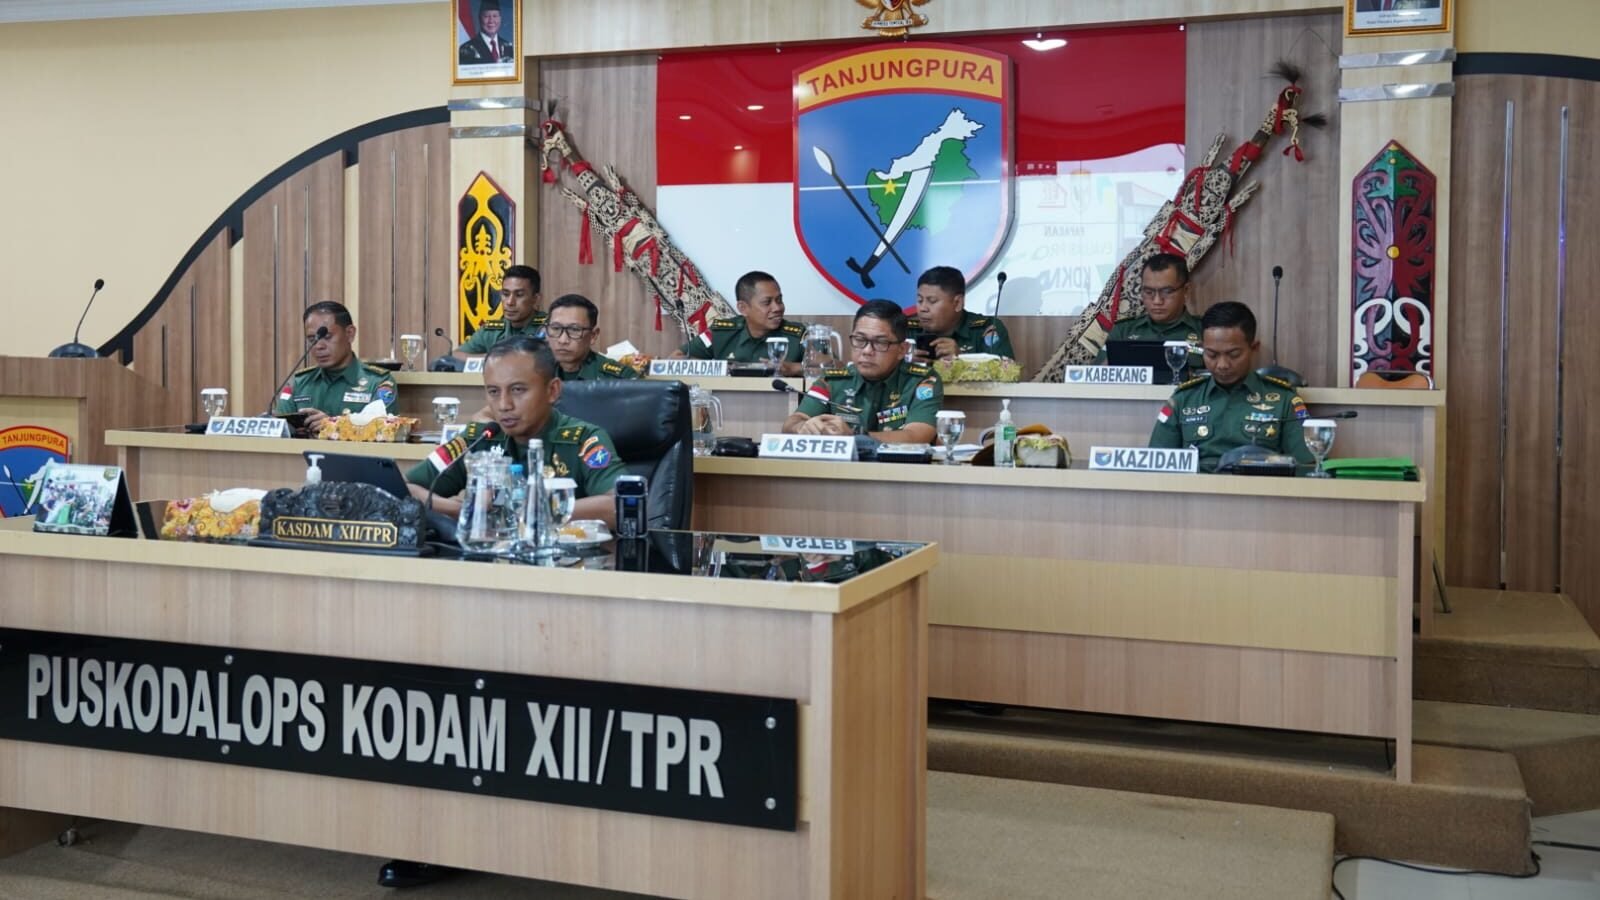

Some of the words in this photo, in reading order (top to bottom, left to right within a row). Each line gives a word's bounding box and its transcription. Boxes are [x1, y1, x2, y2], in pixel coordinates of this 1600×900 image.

[807, 59, 995, 96] TANJUNGPURA
[667, 361, 722, 375] KAPALDAM
[1085, 368, 1148, 382] KABEKANG
[224, 419, 281, 434] ASREN
[2, 431, 64, 448] TANJUNGPURA
[781, 438, 848, 454] ASTER
[1113, 449, 1193, 470] KAZIDAM
[277, 520, 333, 539] KASDAM
[340, 524, 392, 542] XII/TPR
[27, 653, 326, 752] PUSKODALOPS
[342, 683, 507, 773] KODAM
[525, 701, 724, 799] XII/TPR
